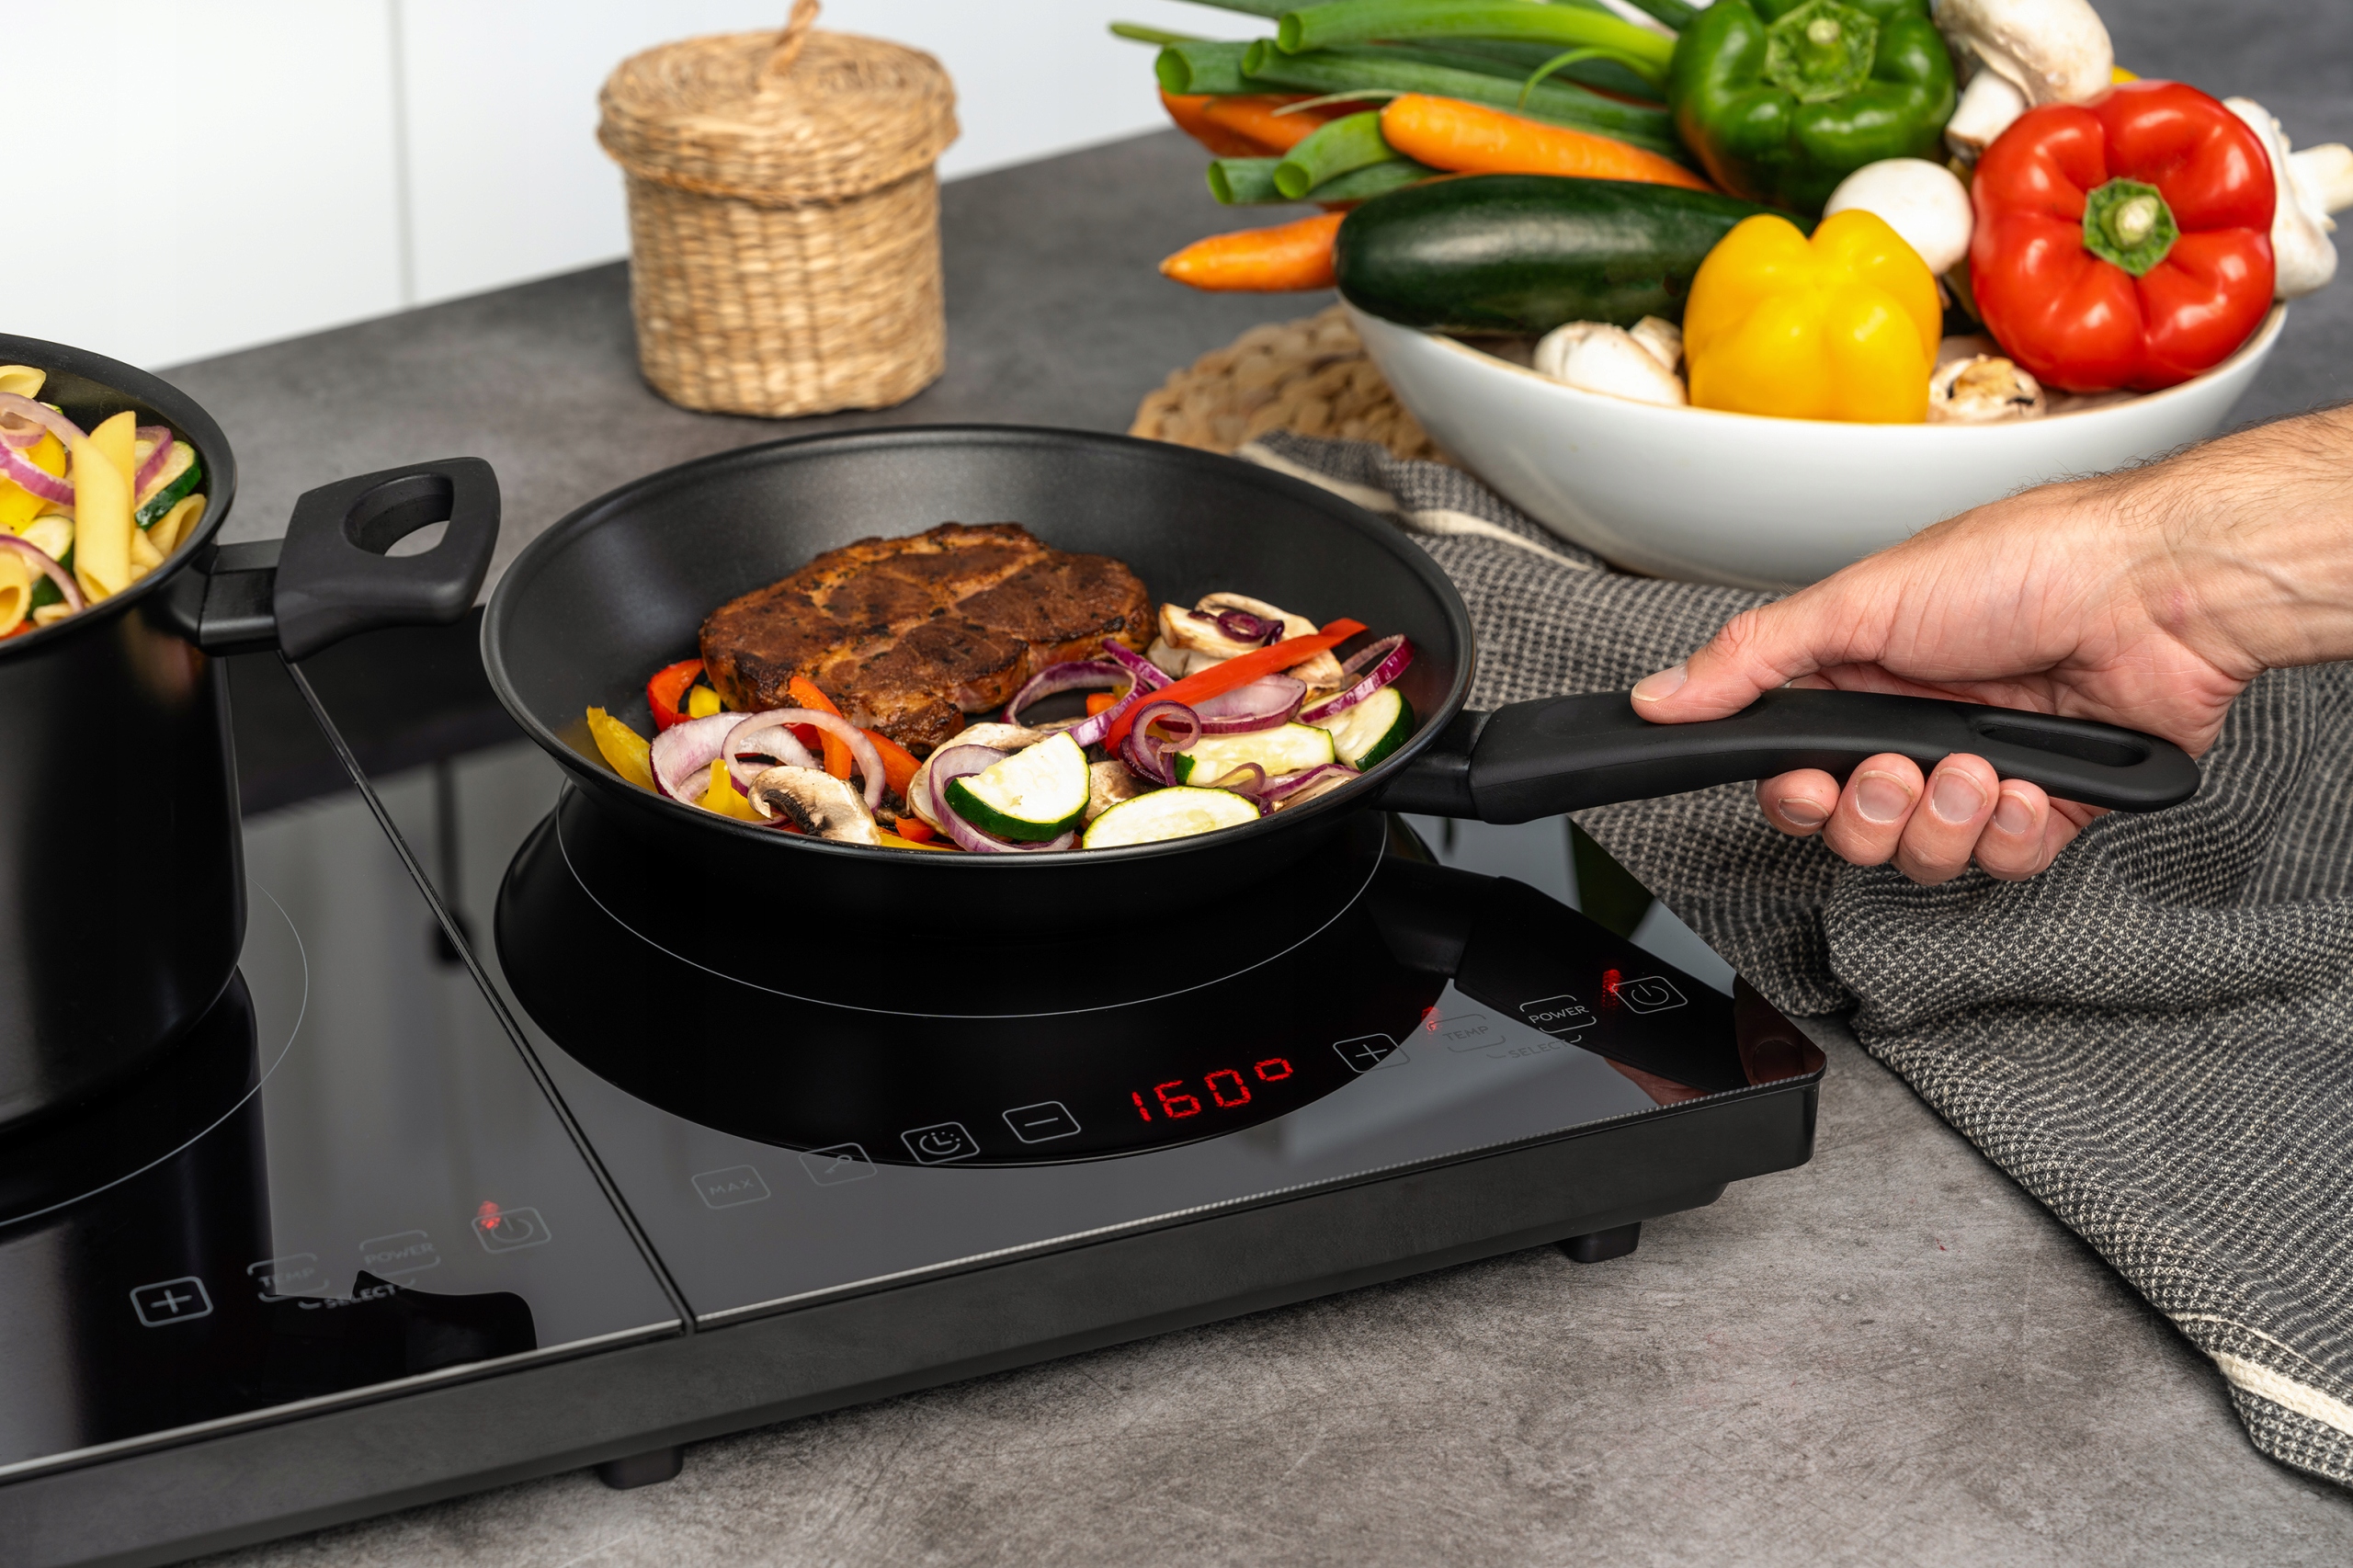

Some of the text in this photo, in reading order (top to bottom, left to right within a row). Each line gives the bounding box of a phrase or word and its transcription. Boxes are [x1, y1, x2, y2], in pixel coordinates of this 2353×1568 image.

[1529, 1005, 1590, 1024] POWER
[1442, 1025, 1489, 1041] TEMP
[1507, 1039, 1567, 1059] SELECT
[709, 1178, 755, 1196] MAX
[364, 1243, 436, 1265] POWER
[258, 1267, 315, 1288] TEMP
[324, 1284, 396, 1309] SELECT
